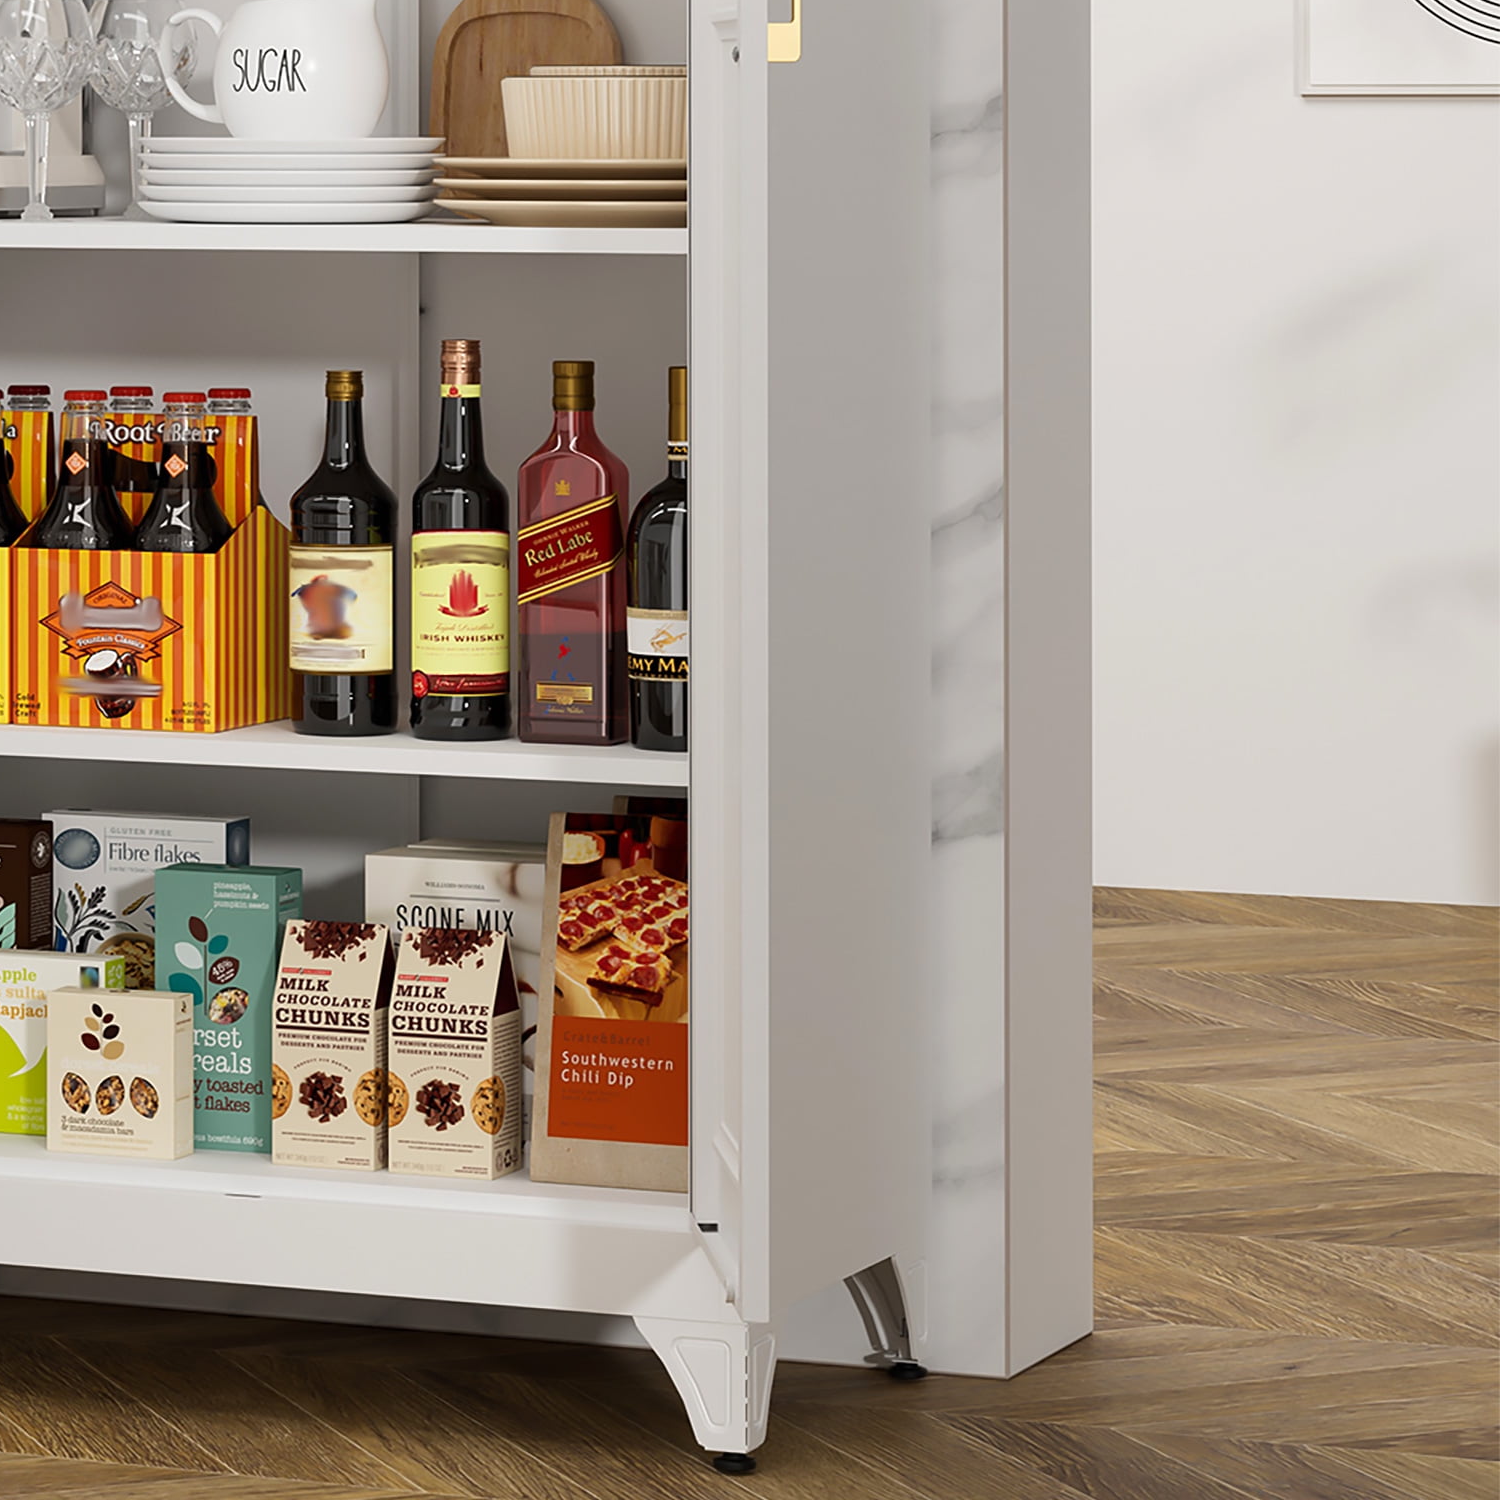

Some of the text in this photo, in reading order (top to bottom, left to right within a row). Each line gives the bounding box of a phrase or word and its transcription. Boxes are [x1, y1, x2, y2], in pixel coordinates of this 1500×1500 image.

[232, 48, 307, 92] SUGAR
[90, 420, 156, 445] Root
[524, 542, 556, 567] Red
[453, 633, 506, 643] WHISKEY
[109, 826, 174, 838] GLUTEN FREE
[108, 842, 202, 864] Fibre flakes
[476, 908, 515, 938] MIX
[279, 977, 330, 992] MILK
[395, 984, 447, 1000] MILK
[276, 993, 372, 1009] CHOCOLATE
[392, 1000, 490, 1017] CHOCOLATE
[275, 1007, 371, 1028] CHUNKS
[391, 1014, 489, 1036] CHUNKS
[193, 1027, 243, 1049] rset
[311, 1034, 352, 1043] CHOCOLATE
[428, 1042, 470, 1051] CHOCOLATE
[193, 1051, 252, 1075] reals
[561, 1050, 674, 1071] Southwestern
[206, 1078, 265, 1096] toasted
[560, 1068, 635, 1090] Chili Dip
[204, 1095, 251, 1113] flakes
